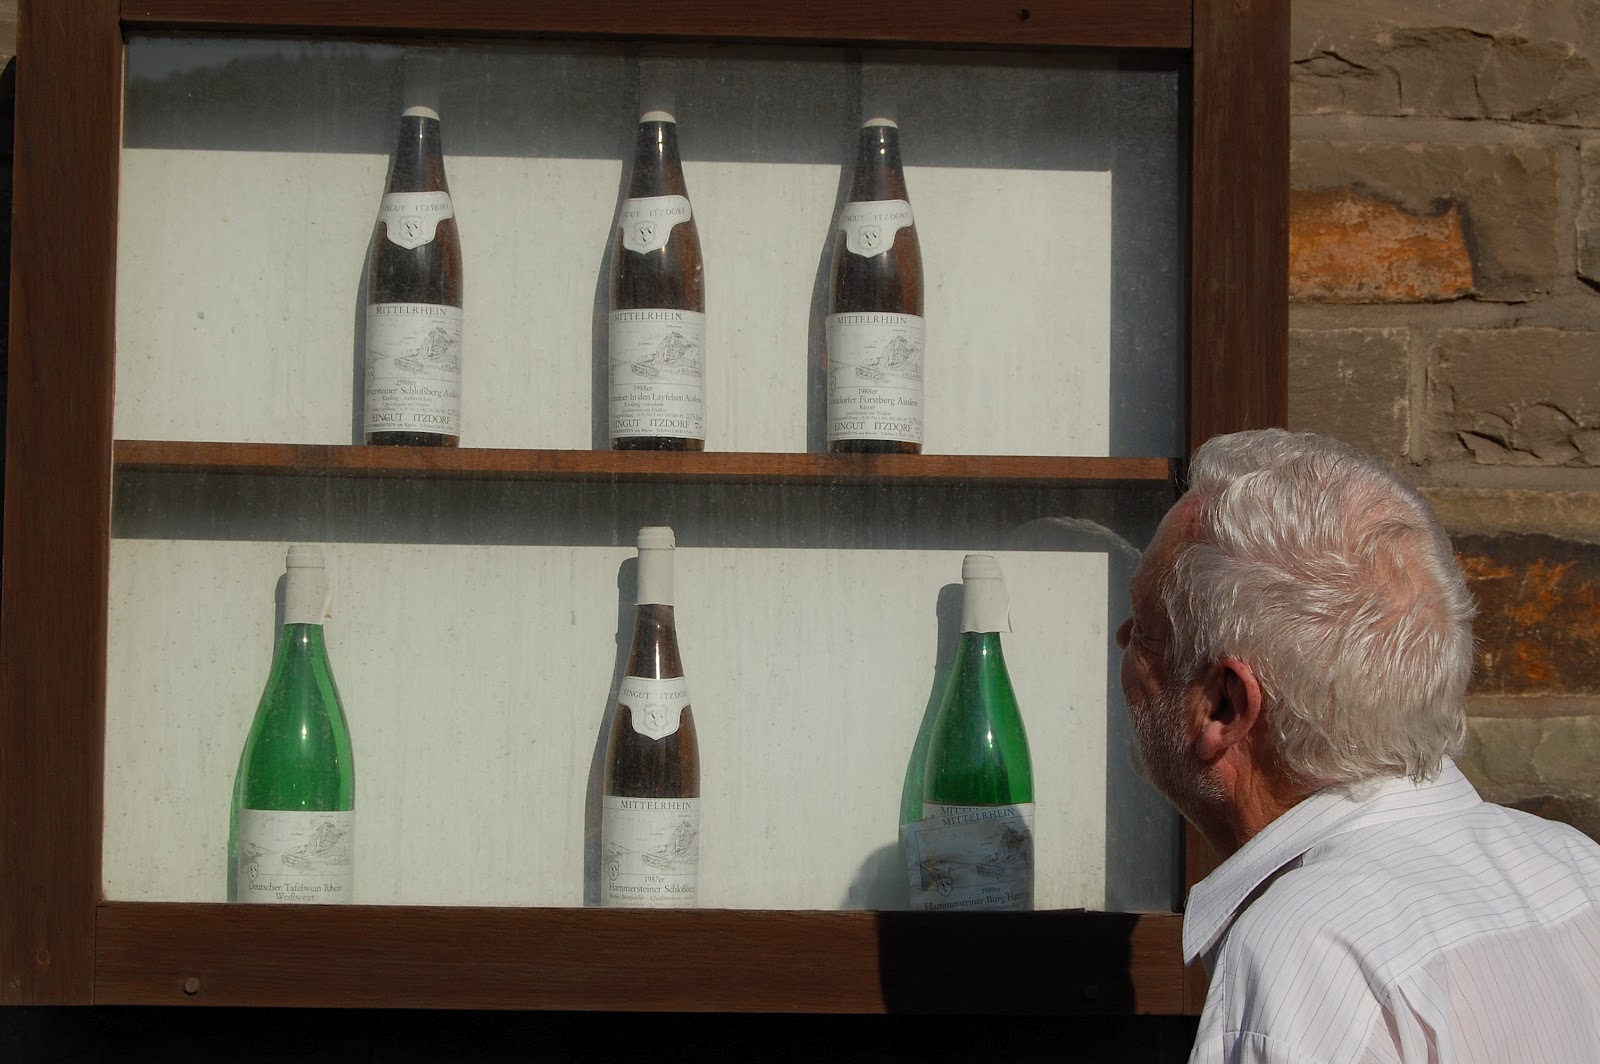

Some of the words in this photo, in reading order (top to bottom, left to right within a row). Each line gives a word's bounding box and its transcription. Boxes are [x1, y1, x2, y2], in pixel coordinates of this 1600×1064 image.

[375, 306, 447, 316] MITTELRHEIN
[614, 311, 683, 321] MITTELRHEIN
[836, 315, 907, 325] MITTELRHEIN
[400, 386, 442, 398] Schloßberg
[860, 395, 895, 406] Forstberg
[413, 413, 451, 424] ITZDORF
[650, 419, 690, 429] ITZDORF
[874, 422, 912, 433] ITZDORF
[620, 800, 692, 810] MITTELRHEIN
[942, 807, 1015, 826] MITTELRHEIN
[248, 882, 282, 892] Deutscher
[284, 883, 321, 892] Tafelwein
[324, 883, 343, 892] Rhein
[608, 882, 662, 893] Hammersteiner
[275, 892, 315, 901] Weißwein
[924, 897, 984, 910] Hammersteiner
